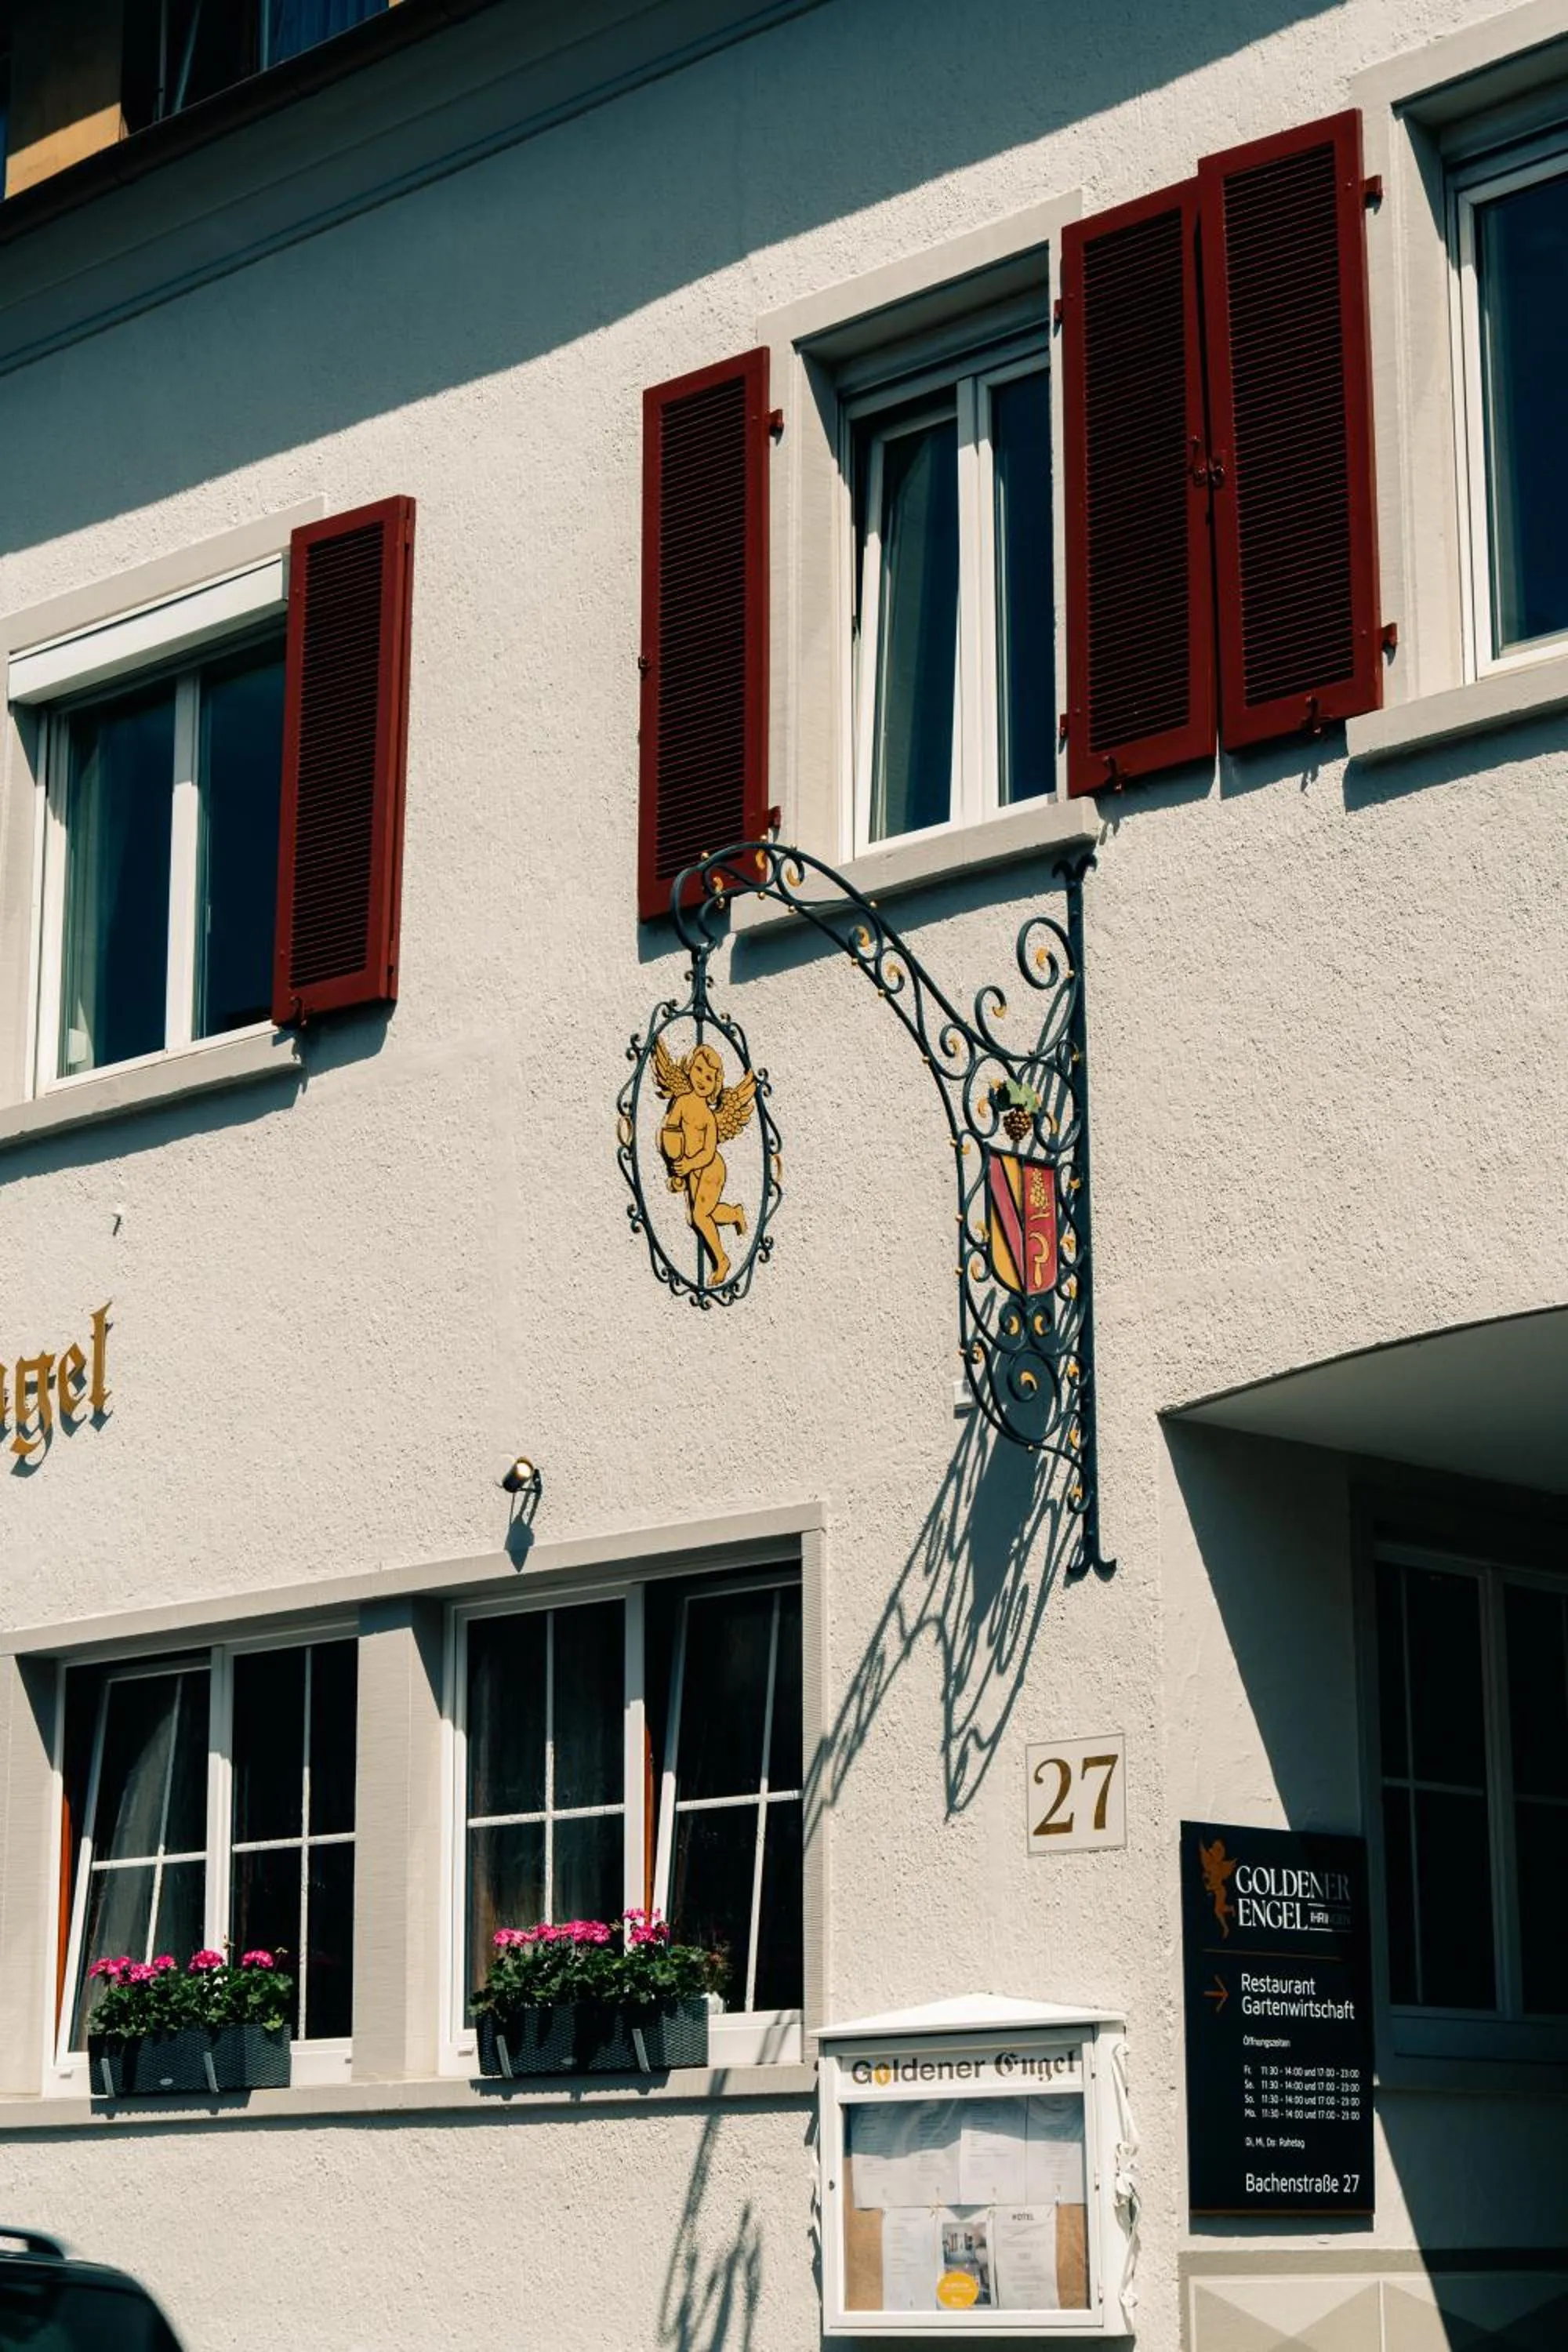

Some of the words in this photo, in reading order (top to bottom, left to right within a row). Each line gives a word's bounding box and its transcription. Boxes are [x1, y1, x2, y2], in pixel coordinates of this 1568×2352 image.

[1033, 1754, 1119, 1836] 27
[1235, 1865, 1351, 1901] GOLDENER
[1238, 1897, 1308, 1931] ENGEL
[1241, 1973, 1316, 1995] Restaurant
[1242, 1995, 1355, 2020] Gartenwirtschaft
[851, 2056, 985, 2086] Goldener
[993, 2049, 1076, 2082] Engel
[1305, 2067, 1316, 2077] und
[1305, 2082, 1316, 2091] und
[1305, 2096, 1316, 2105] und
[1305, 2110, 1316, 2119] und
[1246, 2172, 1339, 2193] Bachenstraße
[1343, 2174, 1360, 2193] 27
